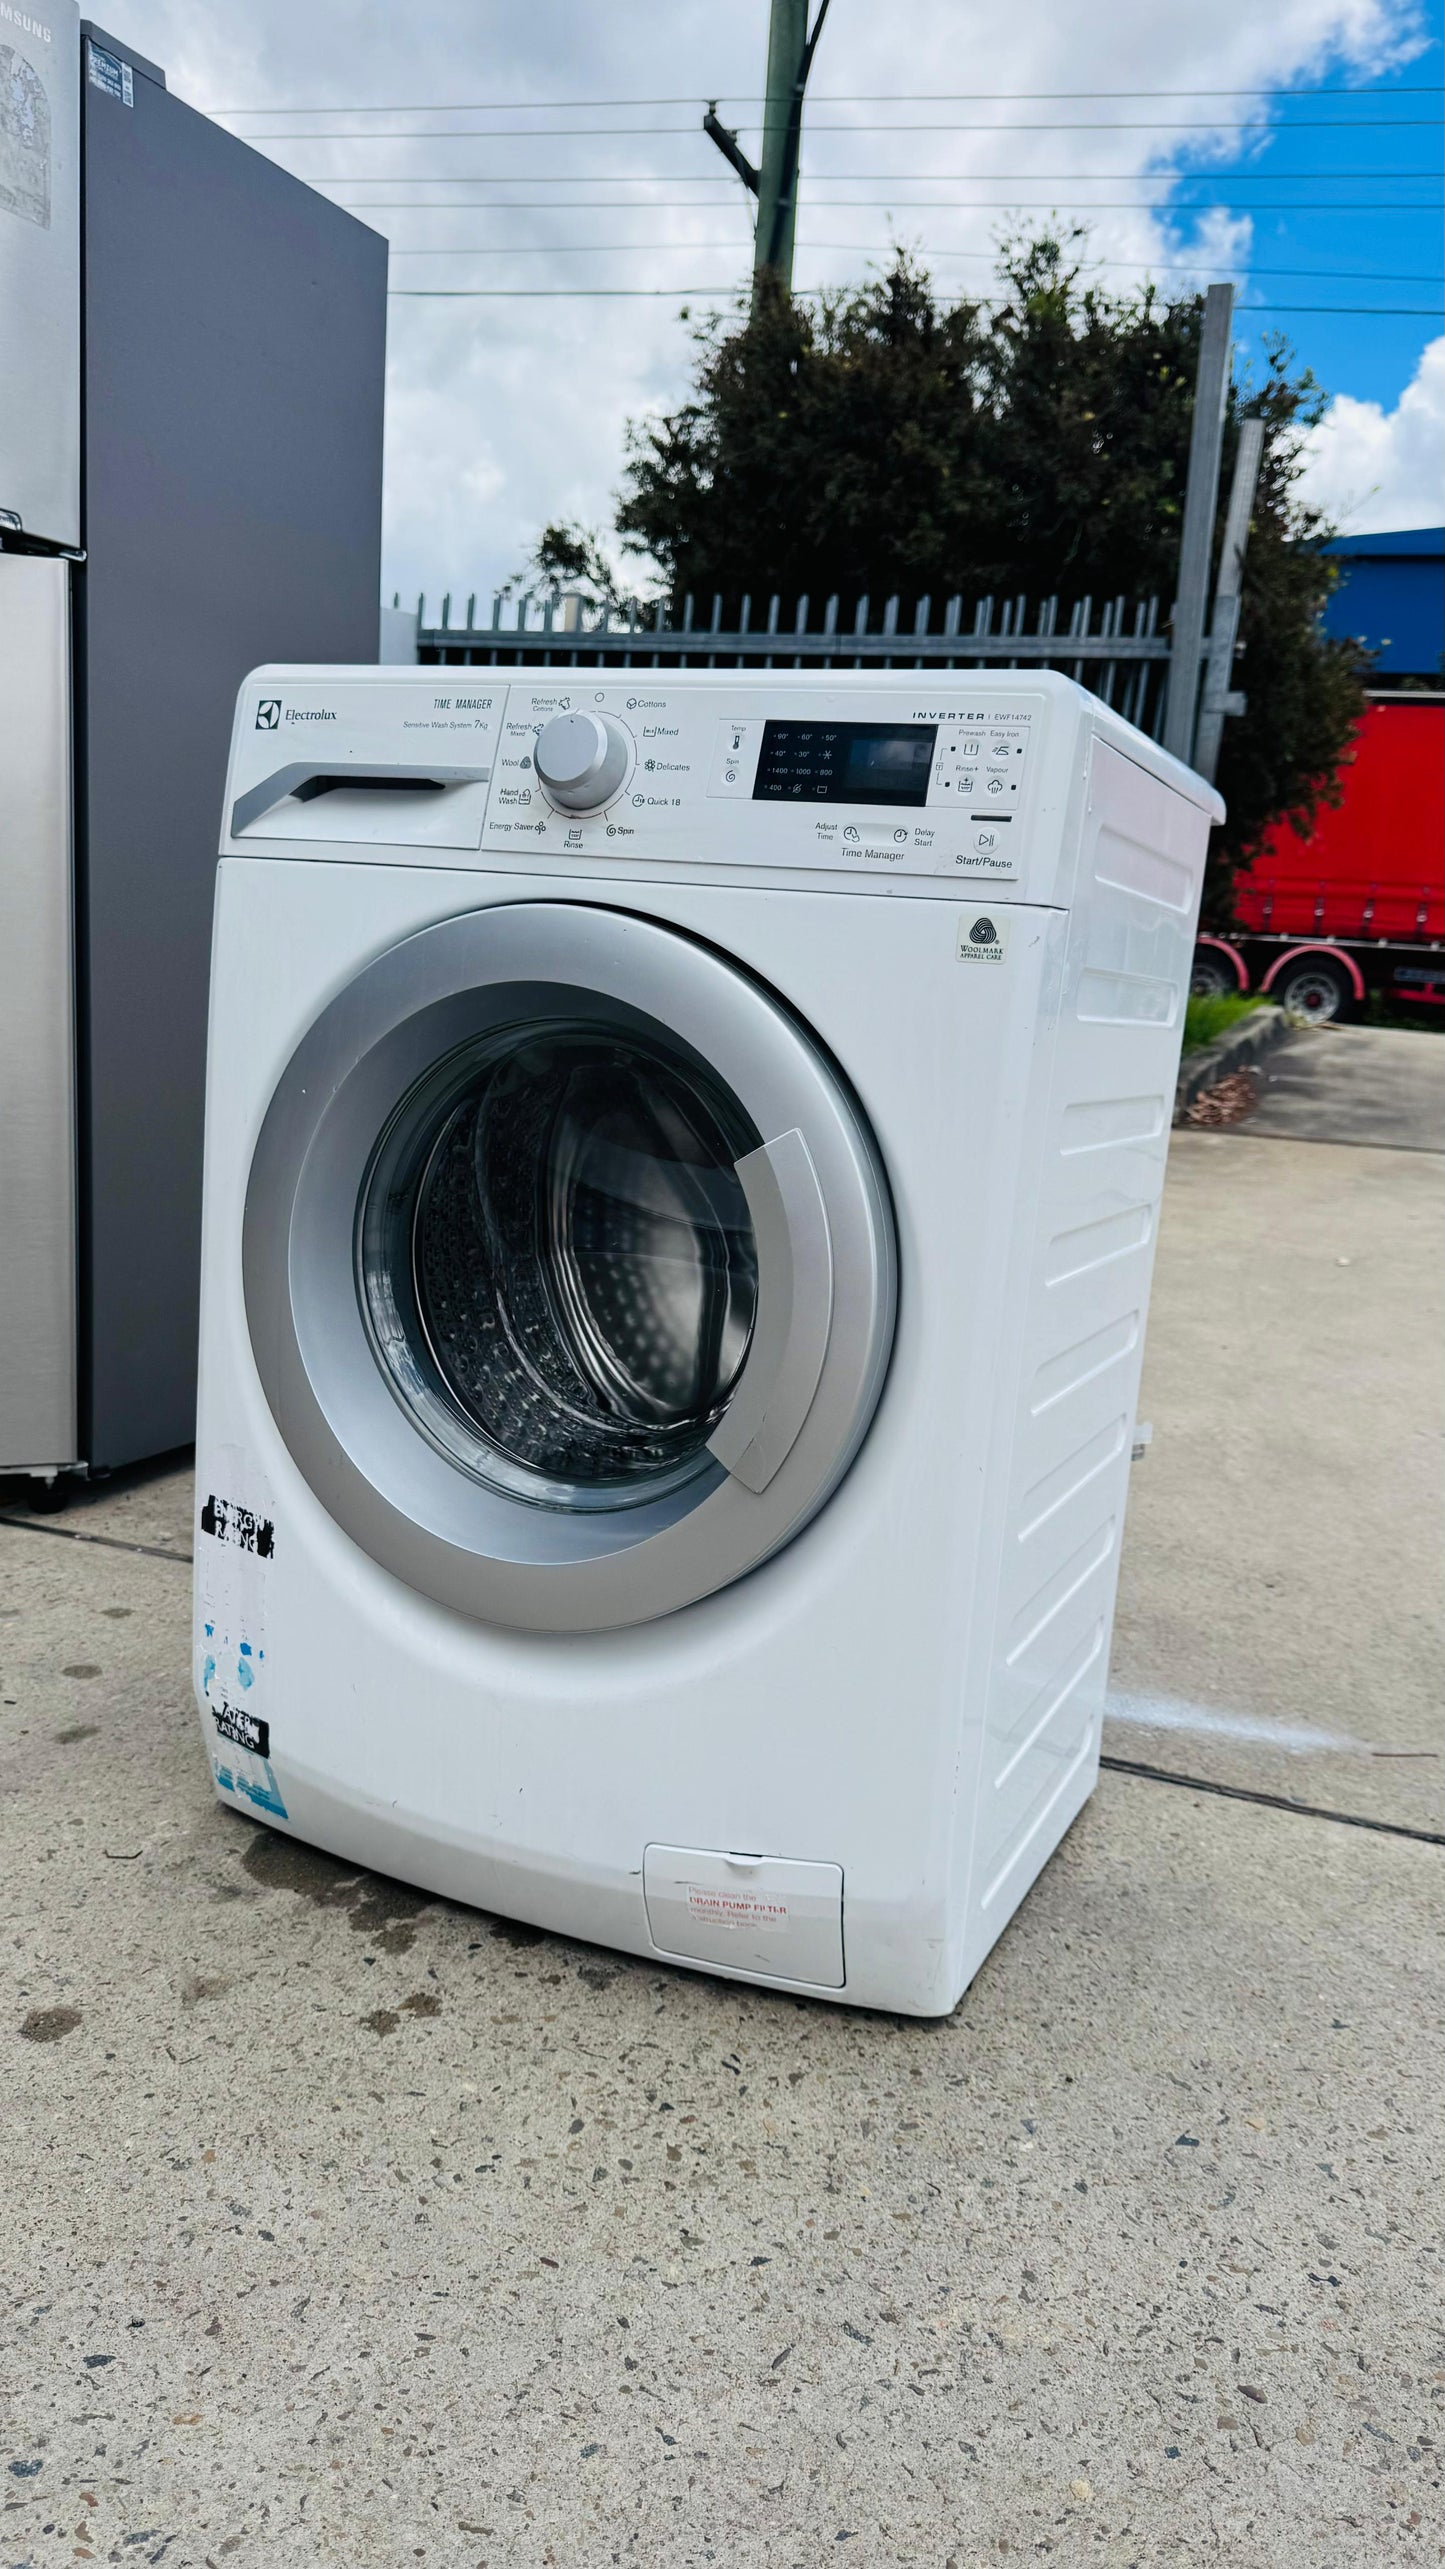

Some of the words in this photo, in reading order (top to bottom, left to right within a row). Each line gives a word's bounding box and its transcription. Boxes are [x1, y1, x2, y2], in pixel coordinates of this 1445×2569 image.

[433, 698, 452, 709] TIME
[455, 698, 493, 709] MANAGER
[531, 697, 558, 706] Refresh
[637, 699, 667, 709] Cottons
[285, 708, 337, 721] Electrolux
[912, 711, 985, 720] INVERTER
[994, 713, 1032, 721] EWF14742
[402, 720, 430, 729] Sensitive
[431, 721, 449, 729] Wash
[449, 721, 473, 731] System
[506, 722, 533, 731] Refresh
[657, 727, 680, 736] Mixed
[958, 728, 986, 737] Prewash
[990, 729, 1006, 739] Easy
[501, 758, 521, 767] Wool
[656, 762, 690, 772] Delicates
[726, 758, 740, 766] Spin
[772, 767, 788, 775] 1400
[986, 766, 1009, 774] Vapour
[500, 788, 519, 797] Hand
[499, 797, 519, 805] Wash
[647, 796, 669, 807] Quick
[671, 798, 681, 807] 18
[489, 821, 512, 832] Energy
[513, 823, 534, 832] Saver
[617, 826, 635, 836] Spin
[815, 822, 838, 832] Adjust
[817, 832, 834, 841] Time
[914, 827, 935, 838] Delay
[563, 840, 584, 849] Rinse
[914, 838, 932, 847] Start
[841, 847, 863, 859] Time
[864, 849, 905, 862] Manager
[955, 855, 1013, 870] Start/Pause
[960, 944, 1004, 954] WOOLMARK
[214, 1500, 262, 1532] ENRGY
[214, 1520, 258, 1553] RANG
[213, 1717, 255, 1750] RATING
[689, 1896, 720, 1907] DRAIN
[722, 1901, 751, 1911] PUMP
